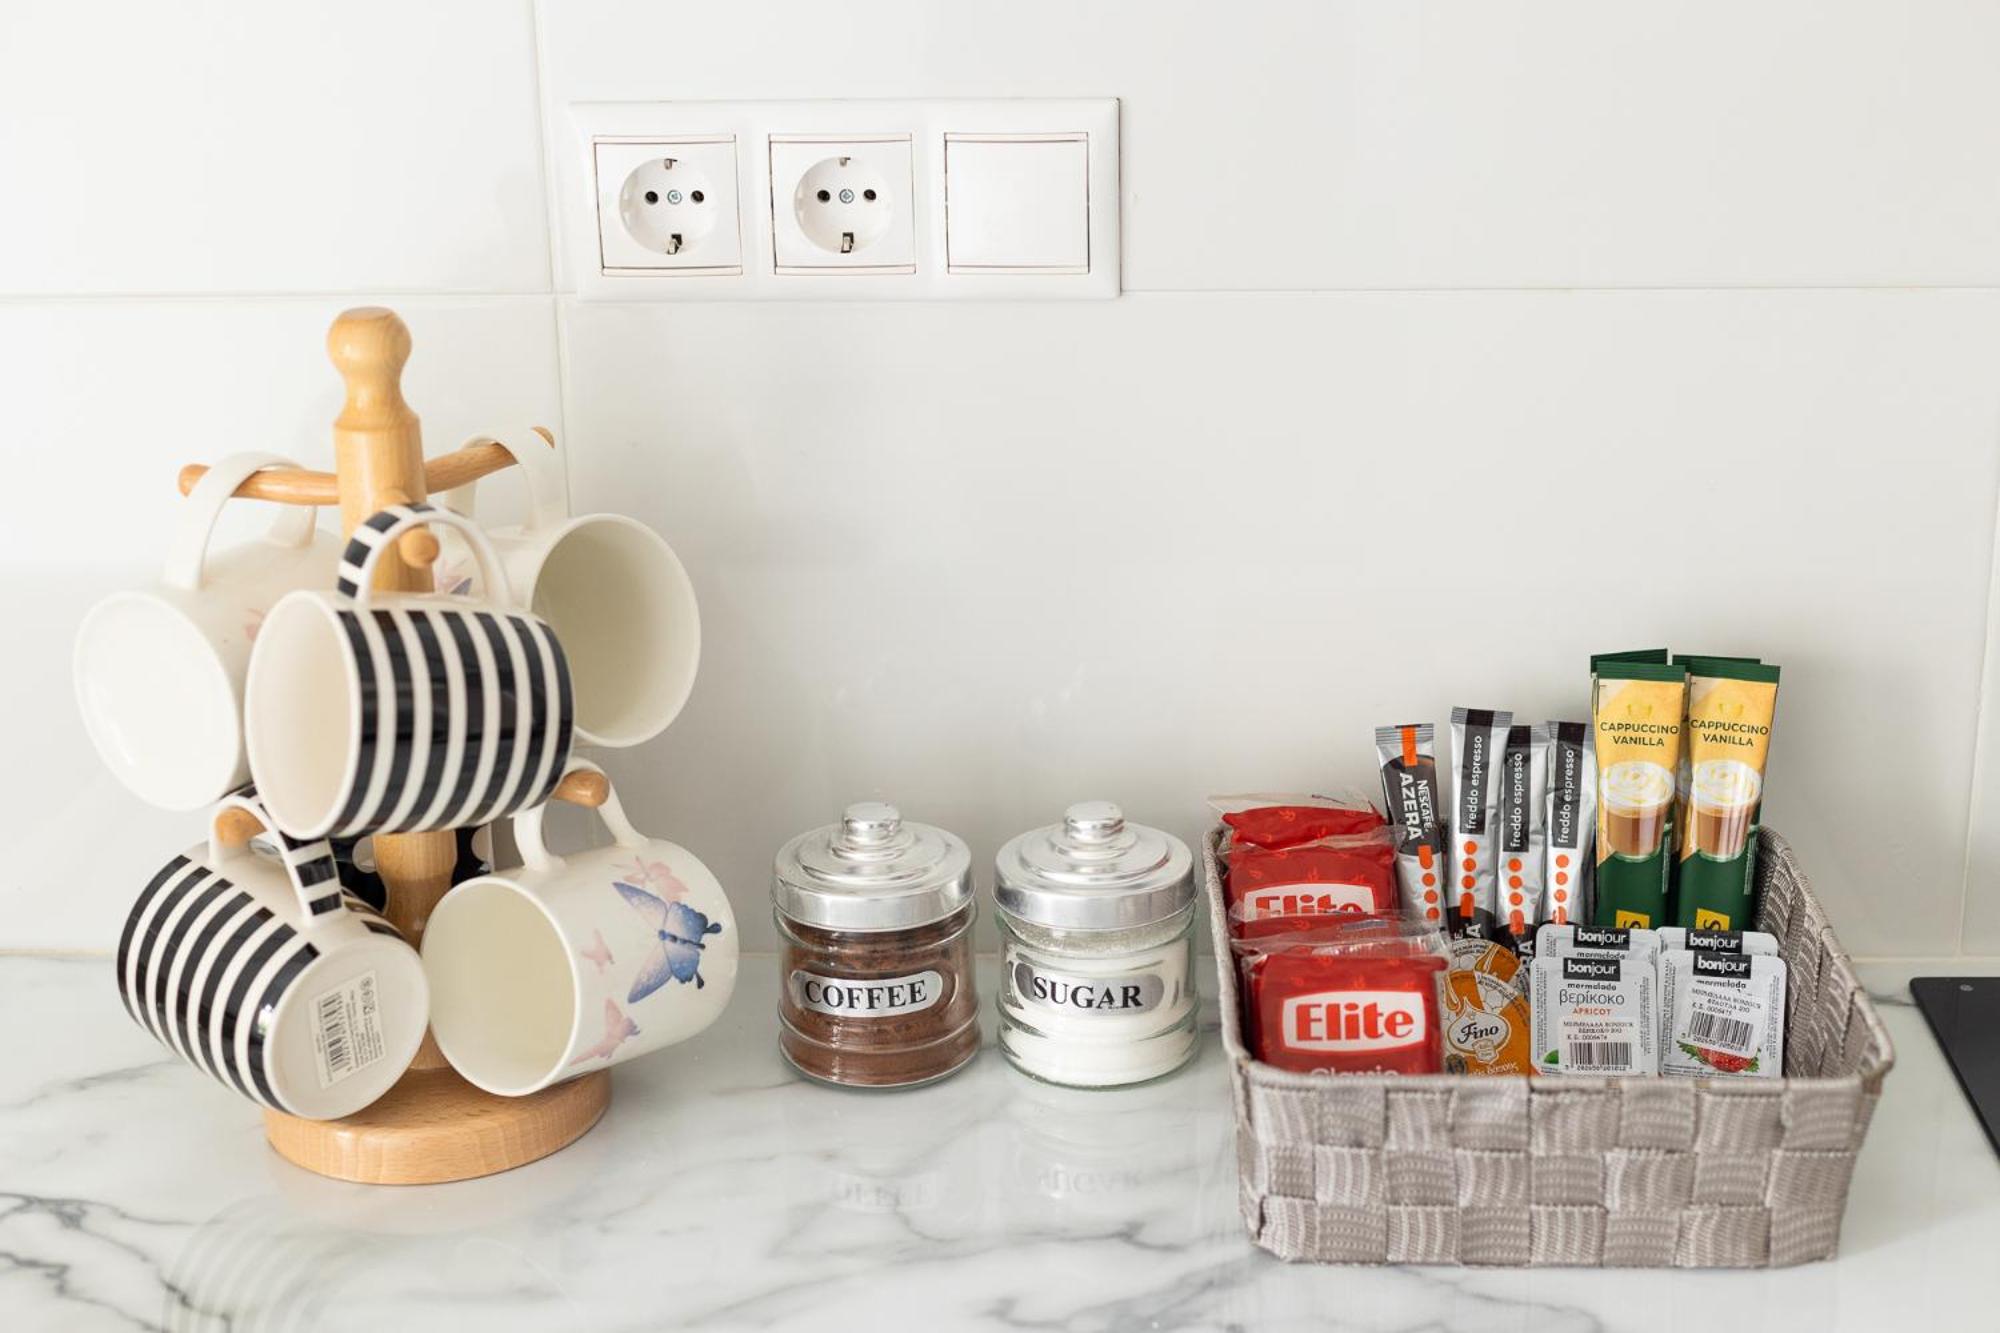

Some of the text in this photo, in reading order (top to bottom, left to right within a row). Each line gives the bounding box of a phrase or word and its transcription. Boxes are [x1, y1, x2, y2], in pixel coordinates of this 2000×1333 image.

[1600, 721, 1679, 735] CAPPUCCINO
[1690, 719, 1769, 736] CAPPUCCINO
[1613, 735, 1664, 747] VANILLA
[1703, 733, 1754, 747] VANILLA
[1465, 735, 1483, 829] freddo espresso
[1510, 753, 1524, 848] freddo espresso
[1558, 749, 1575, 844] freddo espresso
[1400, 772, 1422, 840] AZERA
[1577, 928, 1628, 945] bonjour
[1690, 932, 1740, 950] bonjour
[1567, 959, 1616, 976] bonjour
[1697, 955, 1748, 973] bonjour
[805, 980, 927, 1009] COFFEE
[1033, 976, 1143, 1009] SUGAR
[1560, 988, 1625, 1006] βερίκοκο
[1572, 1008, 1612, 1016] APRICOT
[1296, 1002, 1414, 1041] Elite
[1457, 1022, 1499, 1045] Fino
